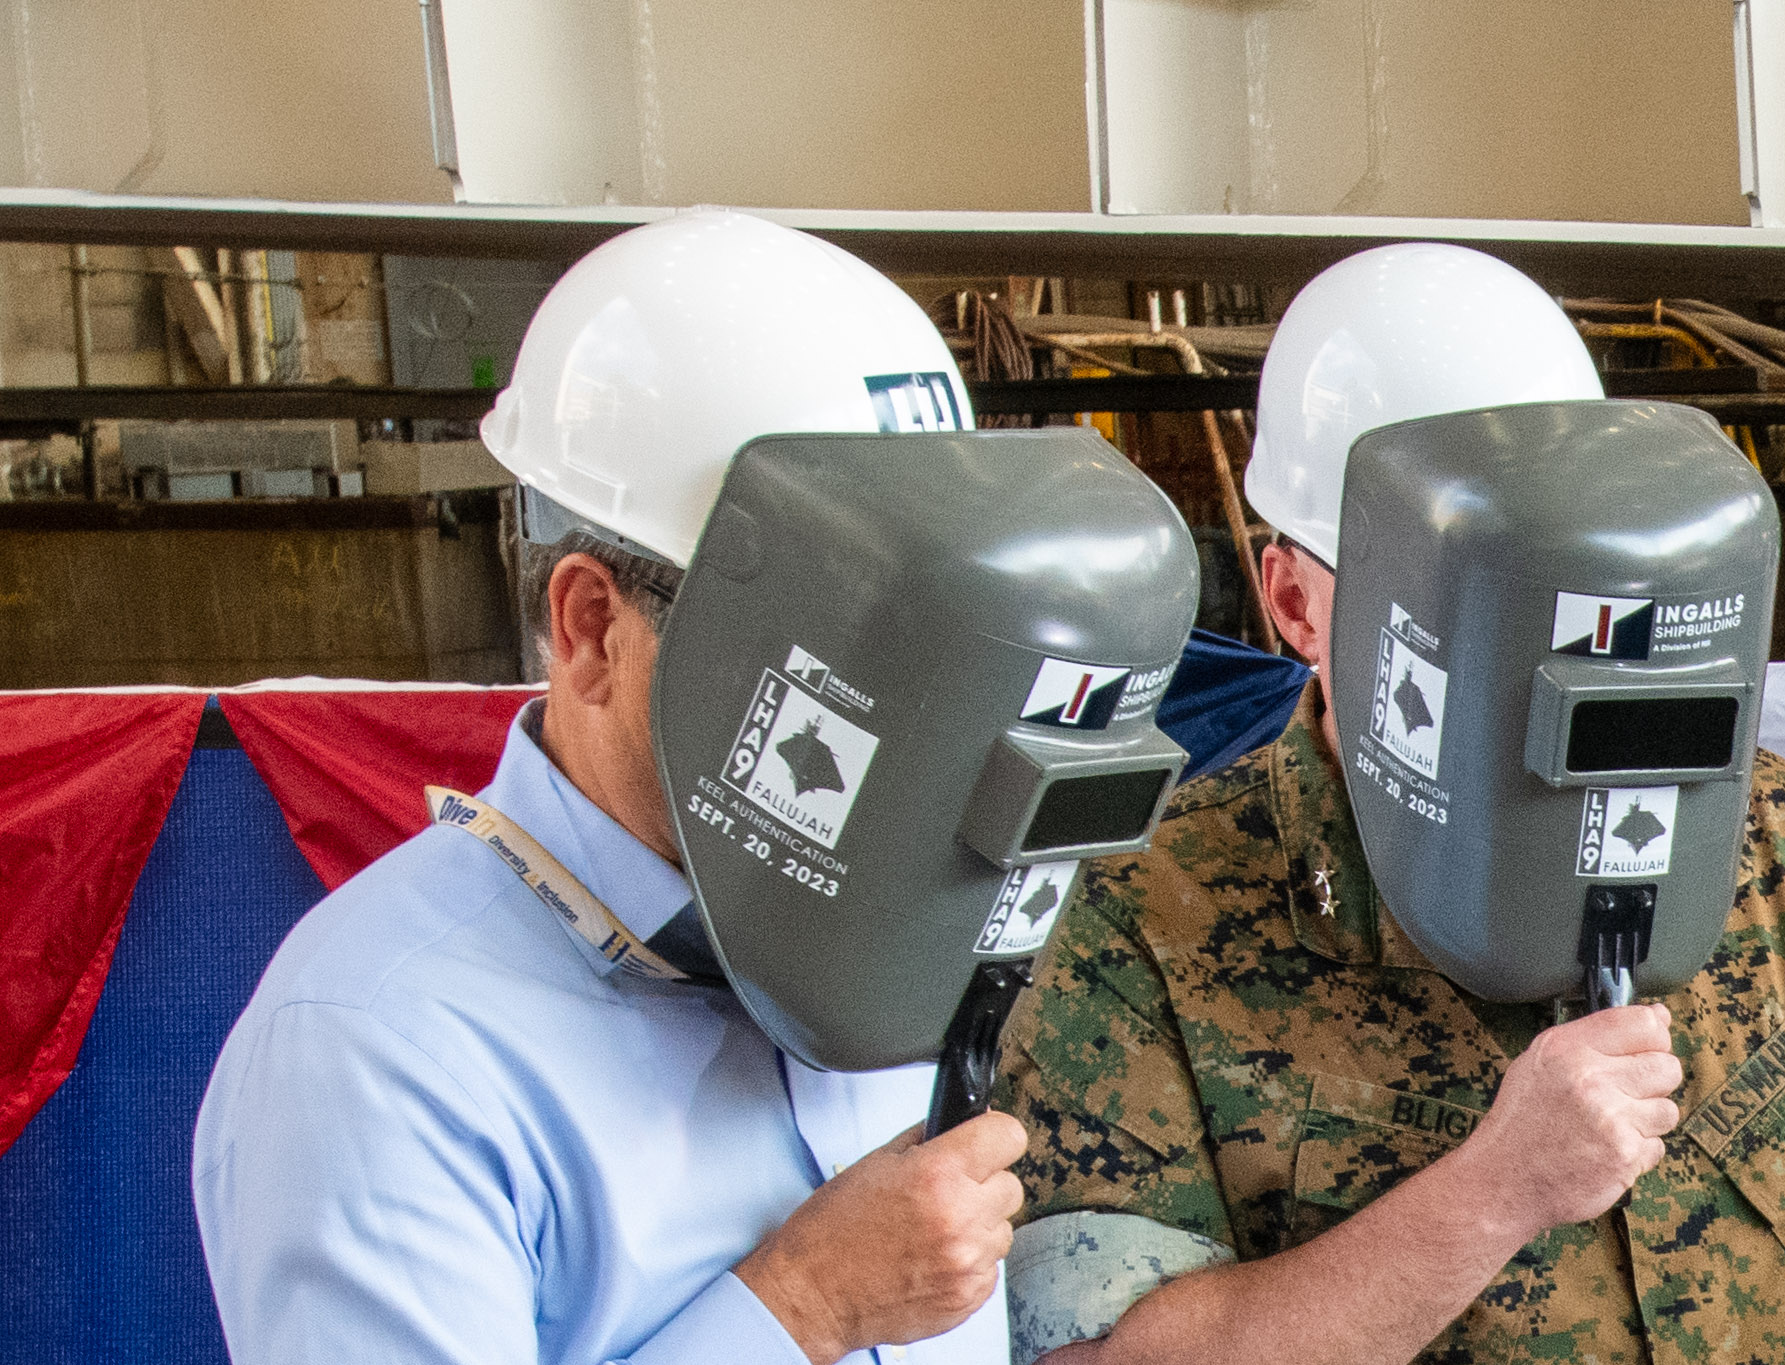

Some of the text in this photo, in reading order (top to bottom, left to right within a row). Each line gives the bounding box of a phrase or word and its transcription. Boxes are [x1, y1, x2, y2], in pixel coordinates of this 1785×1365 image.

[1654, 614, 1741, 639] SHIPBUILDING
[1655, 593, 1745, 624] INGALLS
[1661, 641, 1691, 652] Division
[829, 675, 875, 707] INGALLS
[1375, 638, 1391, 732] LHA9
[732, 681, 777, 780] LHA9
[1385, 729, 1433, 772] FALLUJAH
[1356, 752, 1448, 825] SEPT. 20, 2023
[1376, 750, 1450, 803] AUTHENTICATION
[697, 776, 849, 876] KEEL AUTHENTICATION
[752, 781, 833, 840] FALLUJAH
[1583, 793, 1603, 870] LHA9
[687, 794, 841, 897] SEPT. 20, 2023
[1603, 859, 1665, 873] FALLUJAH
[488, 835, 579, 924] Diversity & Inclusion
[983, 868, 1022, 947] LHA9
